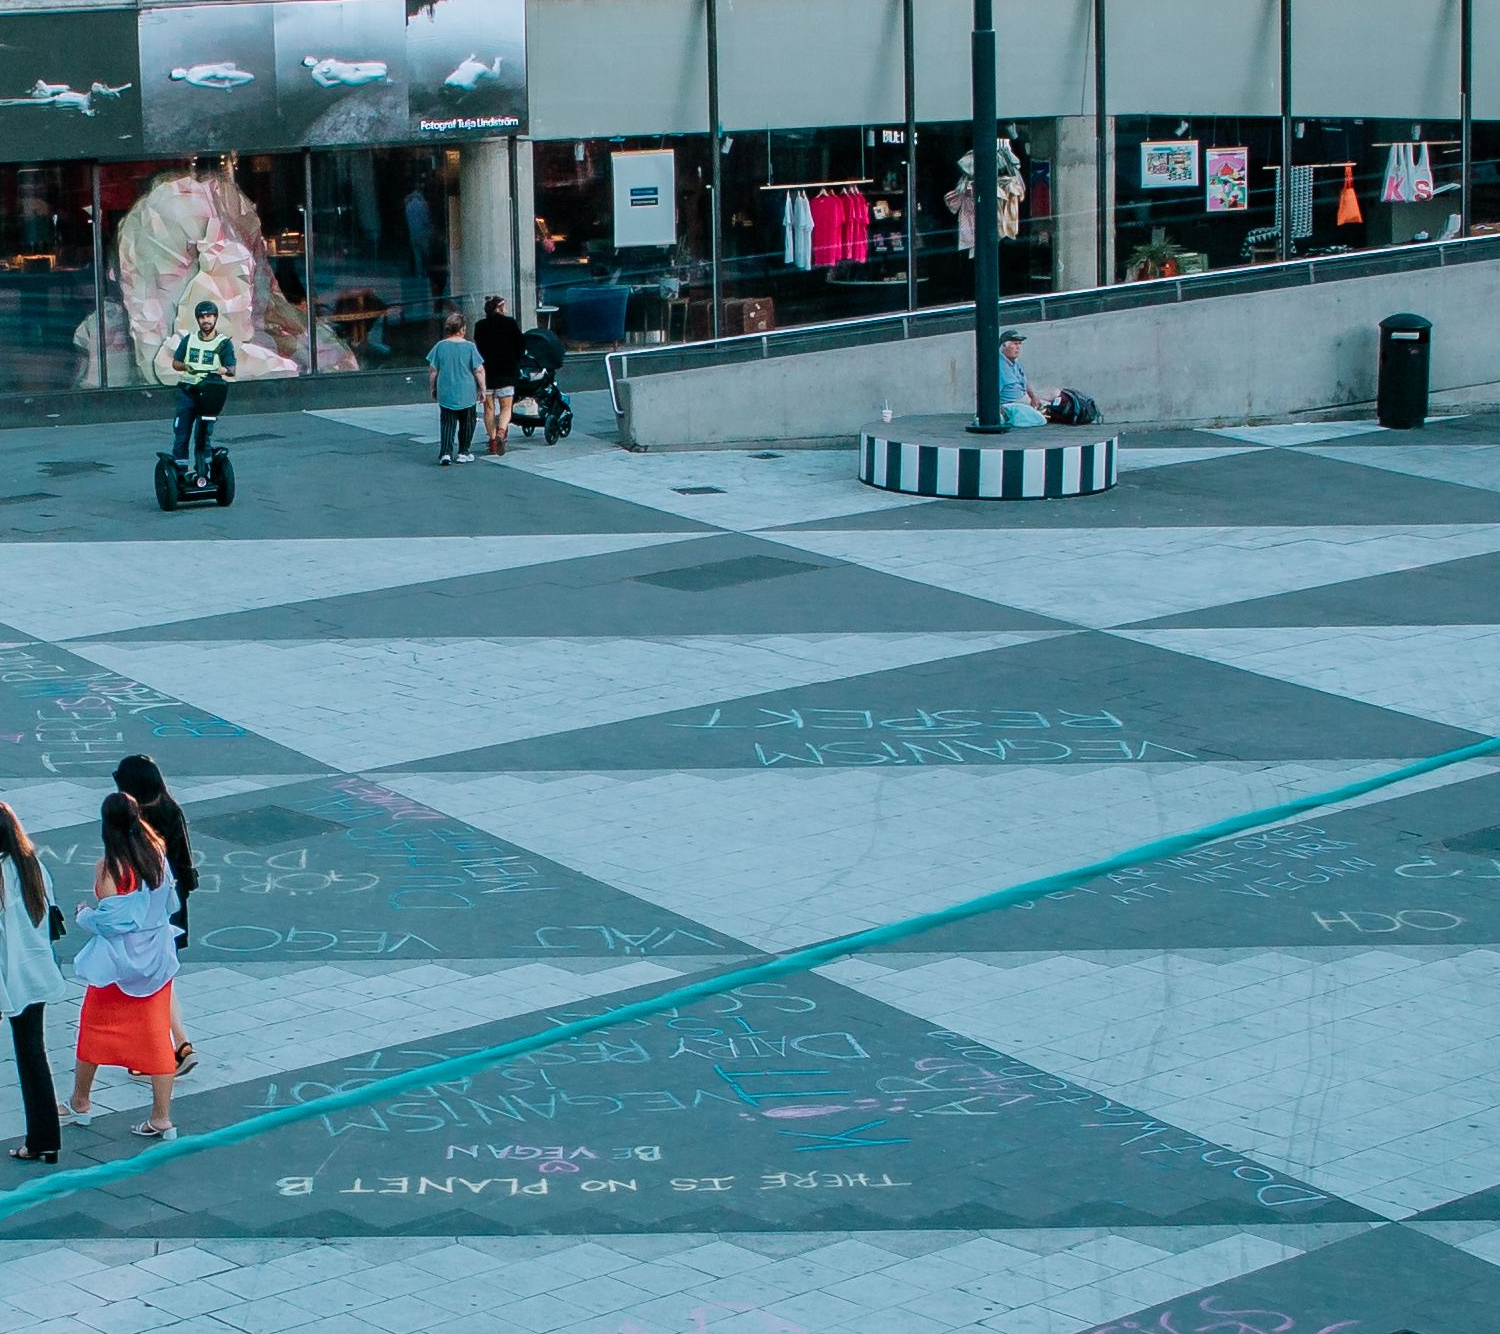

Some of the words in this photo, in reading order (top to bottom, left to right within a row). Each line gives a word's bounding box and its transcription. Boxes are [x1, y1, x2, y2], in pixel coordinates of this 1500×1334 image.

[420, 119, 456, 132] Fotograf
[477, 117, 519, 128] Lindström
[665, 708, 1122, 730] RESPEKT
[754, 738, 1197, 765] VEGANISM
[1310, 908, 1462, 934] OCH
[321, 1088, 741, 1137] VEGANISM
[446, 1144, 597, 1162] VEGAN
[611, 1145, 662, 1162] BE
[275, 1175, 314, 1196] B
[339, 1174, 548, 1196] PLANET
[578, 1177, 637, 1193] NO
[670, 1175, 734, 1192] IS
[759, 1170, 912, 1190] THERE
